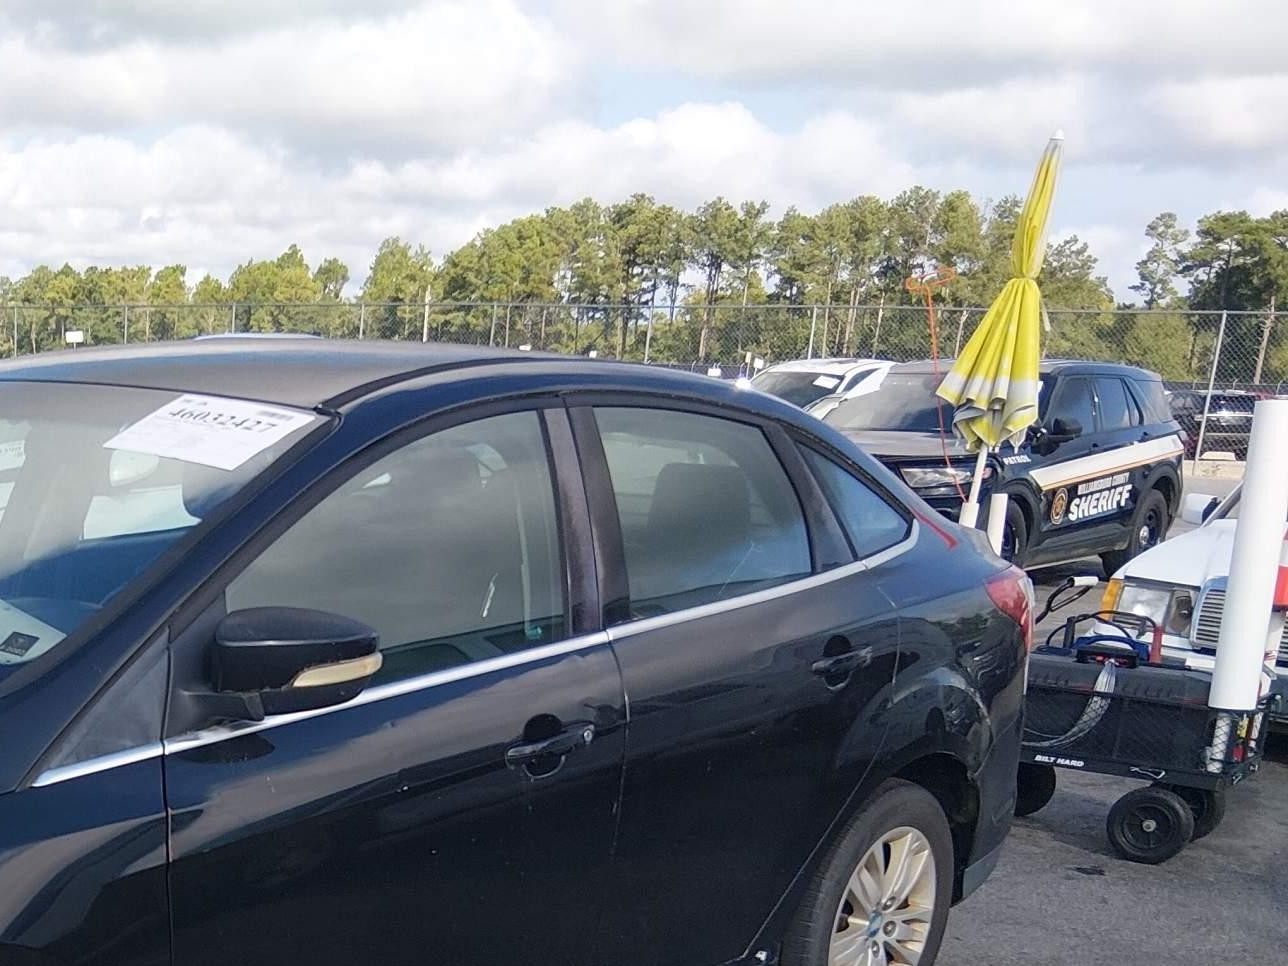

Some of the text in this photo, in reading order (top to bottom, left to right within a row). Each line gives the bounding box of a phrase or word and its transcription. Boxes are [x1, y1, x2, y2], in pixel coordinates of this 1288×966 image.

[168, 408, 278, 433] 46032427
[1002, 455, 1032, 465] PATROL
[1068, 484, 1133, 521] SHERIFF
